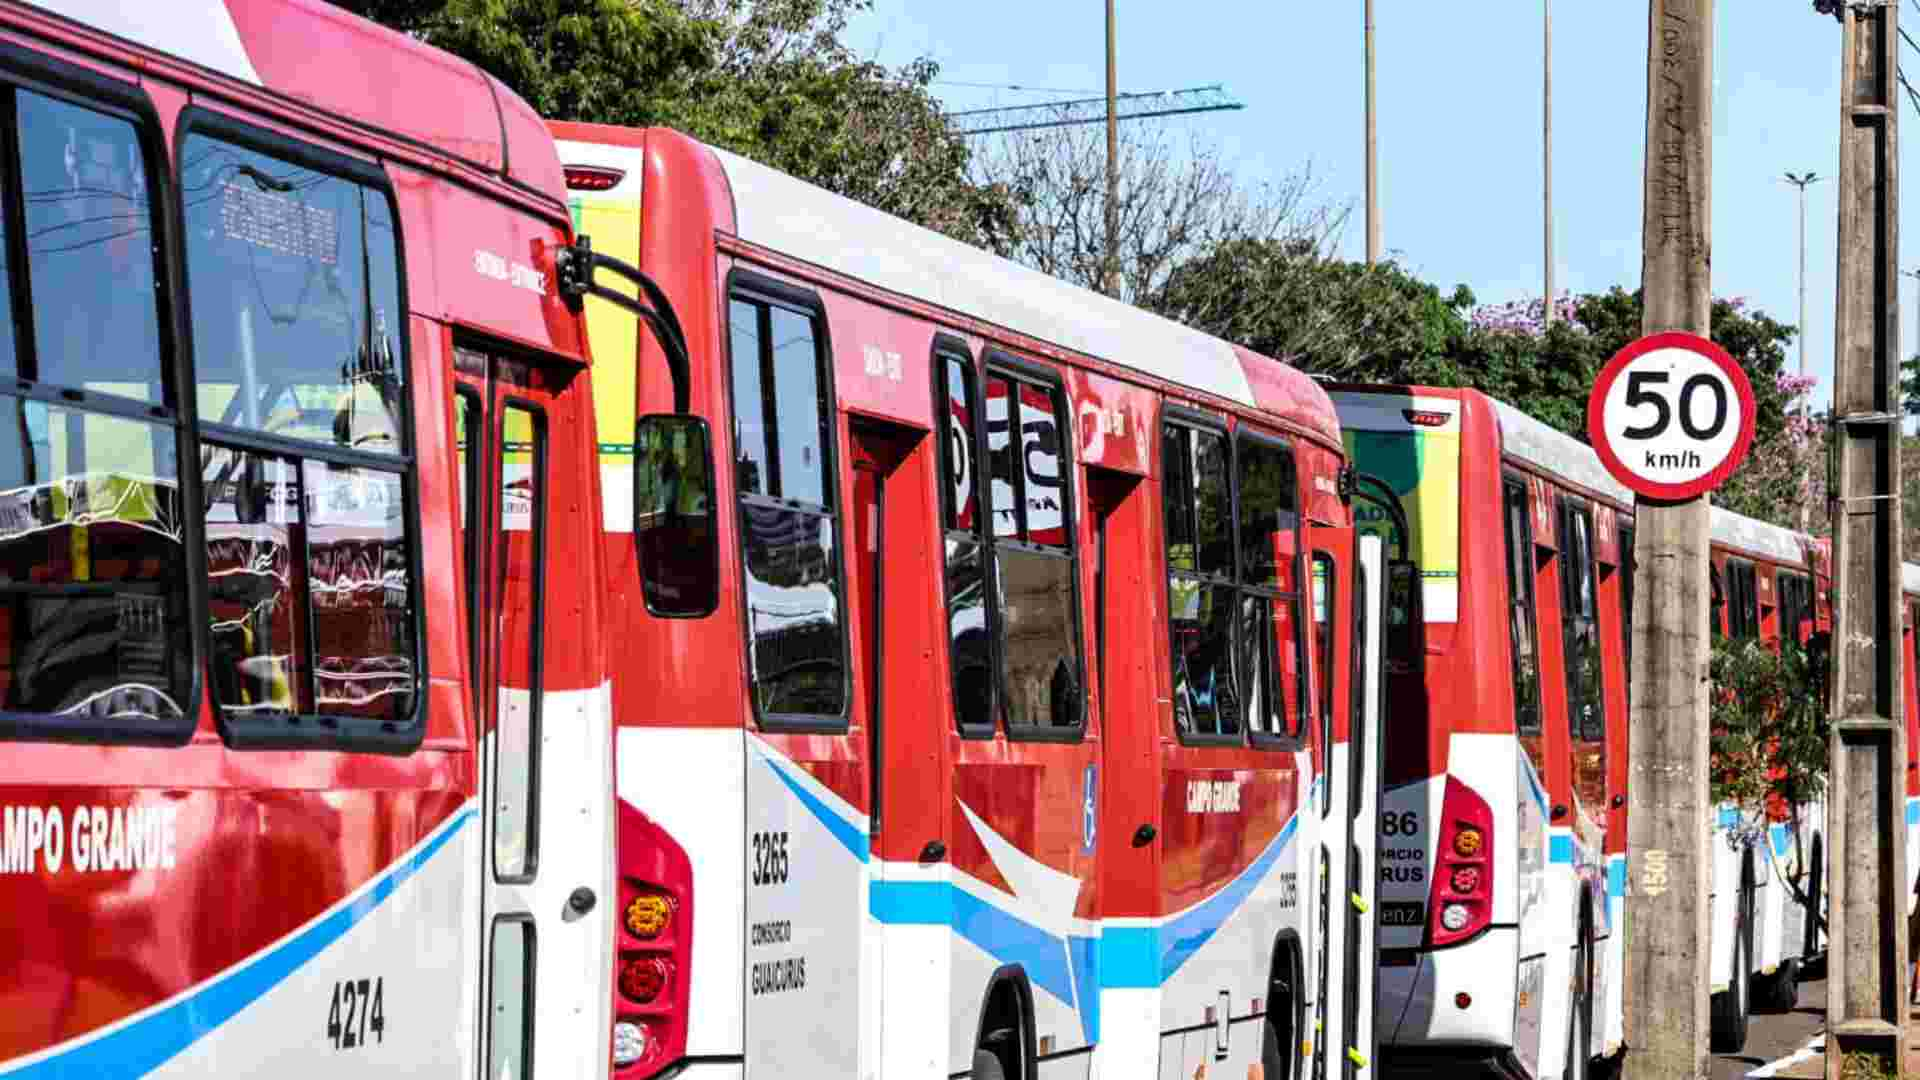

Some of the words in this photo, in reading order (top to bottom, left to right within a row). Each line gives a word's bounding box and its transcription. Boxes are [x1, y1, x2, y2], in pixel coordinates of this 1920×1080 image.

[1622, 371, 1728, 441] 50
[1645, 449, 1702, 469] km/h
[71, 804, 177, 874] GRANDE
[752, 831, 789, 887] 3265
[752, 919, 791, 947] CONSORCIO
[752, 956, 807, 996] GUAICURUS
[328, 976, 384, 1050] 4274
